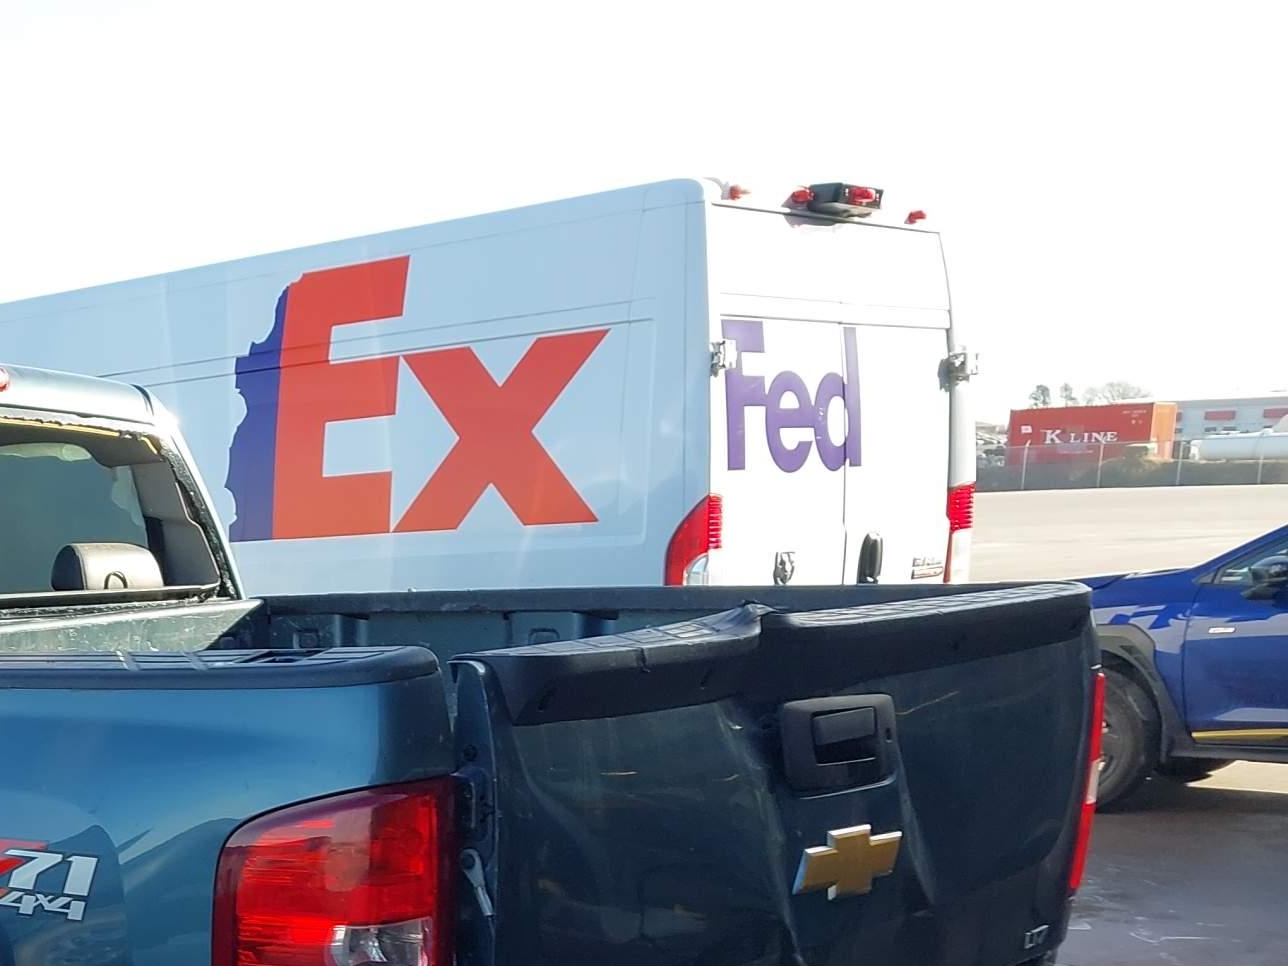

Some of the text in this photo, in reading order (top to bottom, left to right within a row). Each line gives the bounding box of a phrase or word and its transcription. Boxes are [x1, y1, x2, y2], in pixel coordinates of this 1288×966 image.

[722, 318, 862, 473] Fed
[1044, 429, 1062, 444] K
[1069, 431, 1118, 444] LINE
